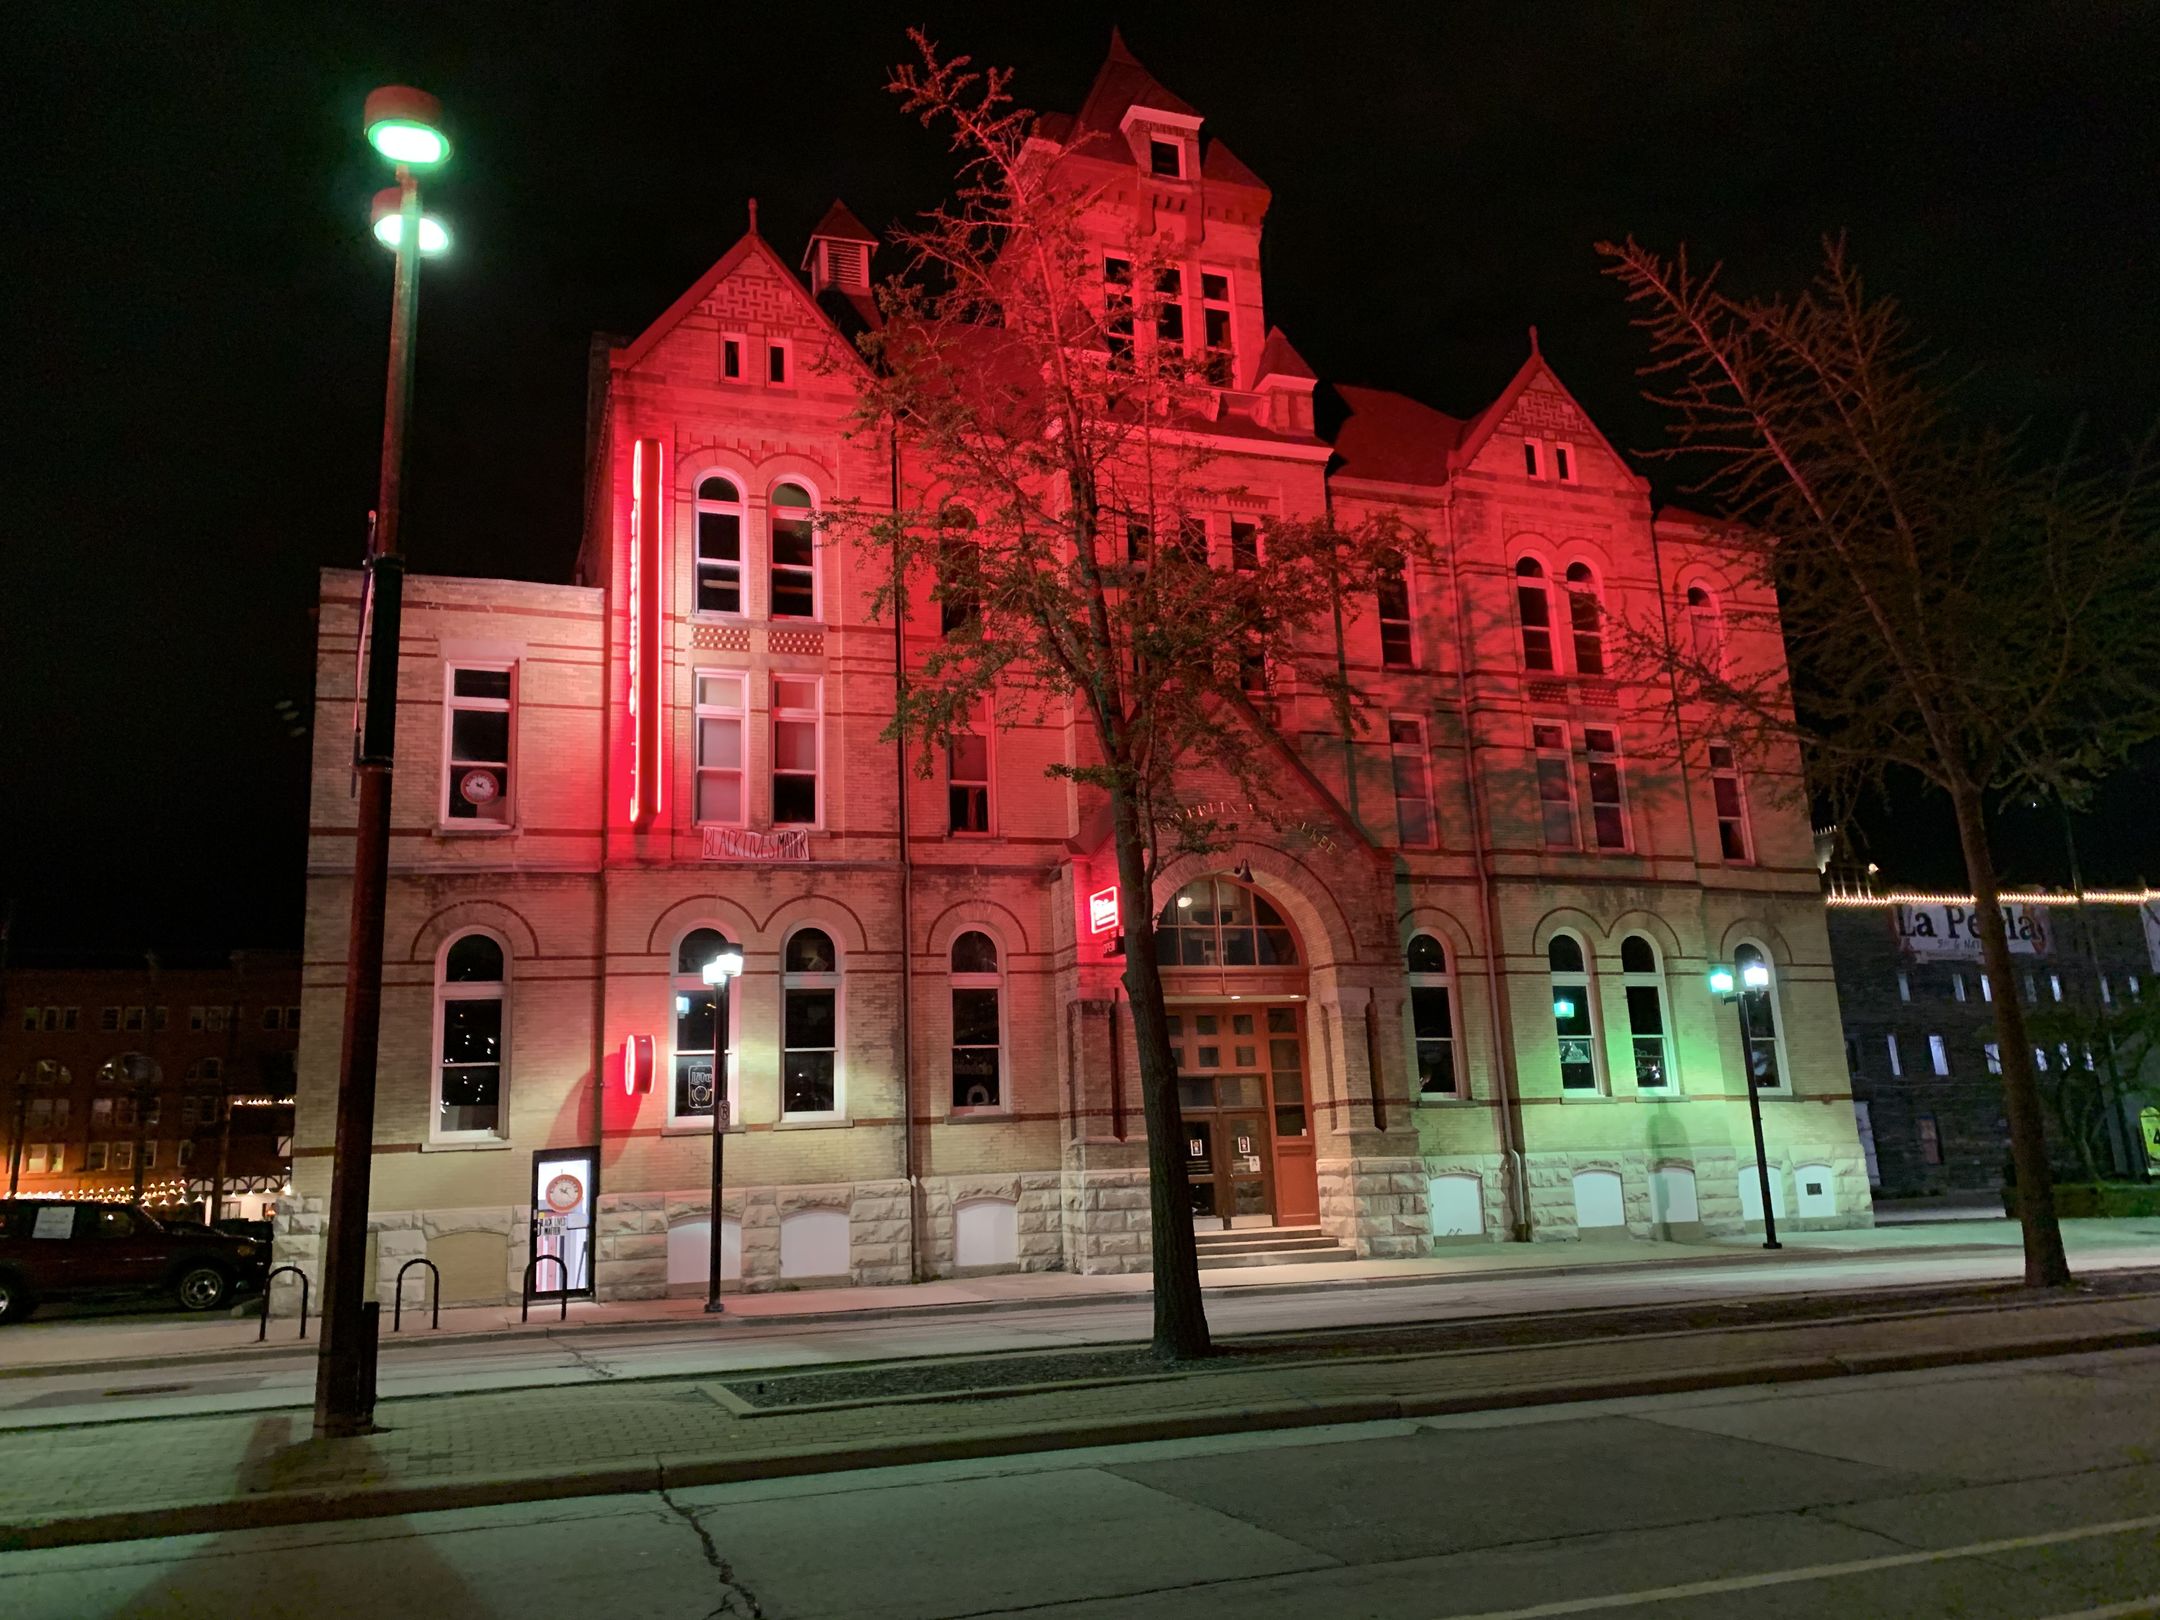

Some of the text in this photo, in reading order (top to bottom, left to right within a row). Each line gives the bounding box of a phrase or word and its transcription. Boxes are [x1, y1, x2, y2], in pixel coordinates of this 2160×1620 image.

[704, 828, 808, 860] BLACK LIVES MATTER
[1895, 904, 2045, 941] La Pela
